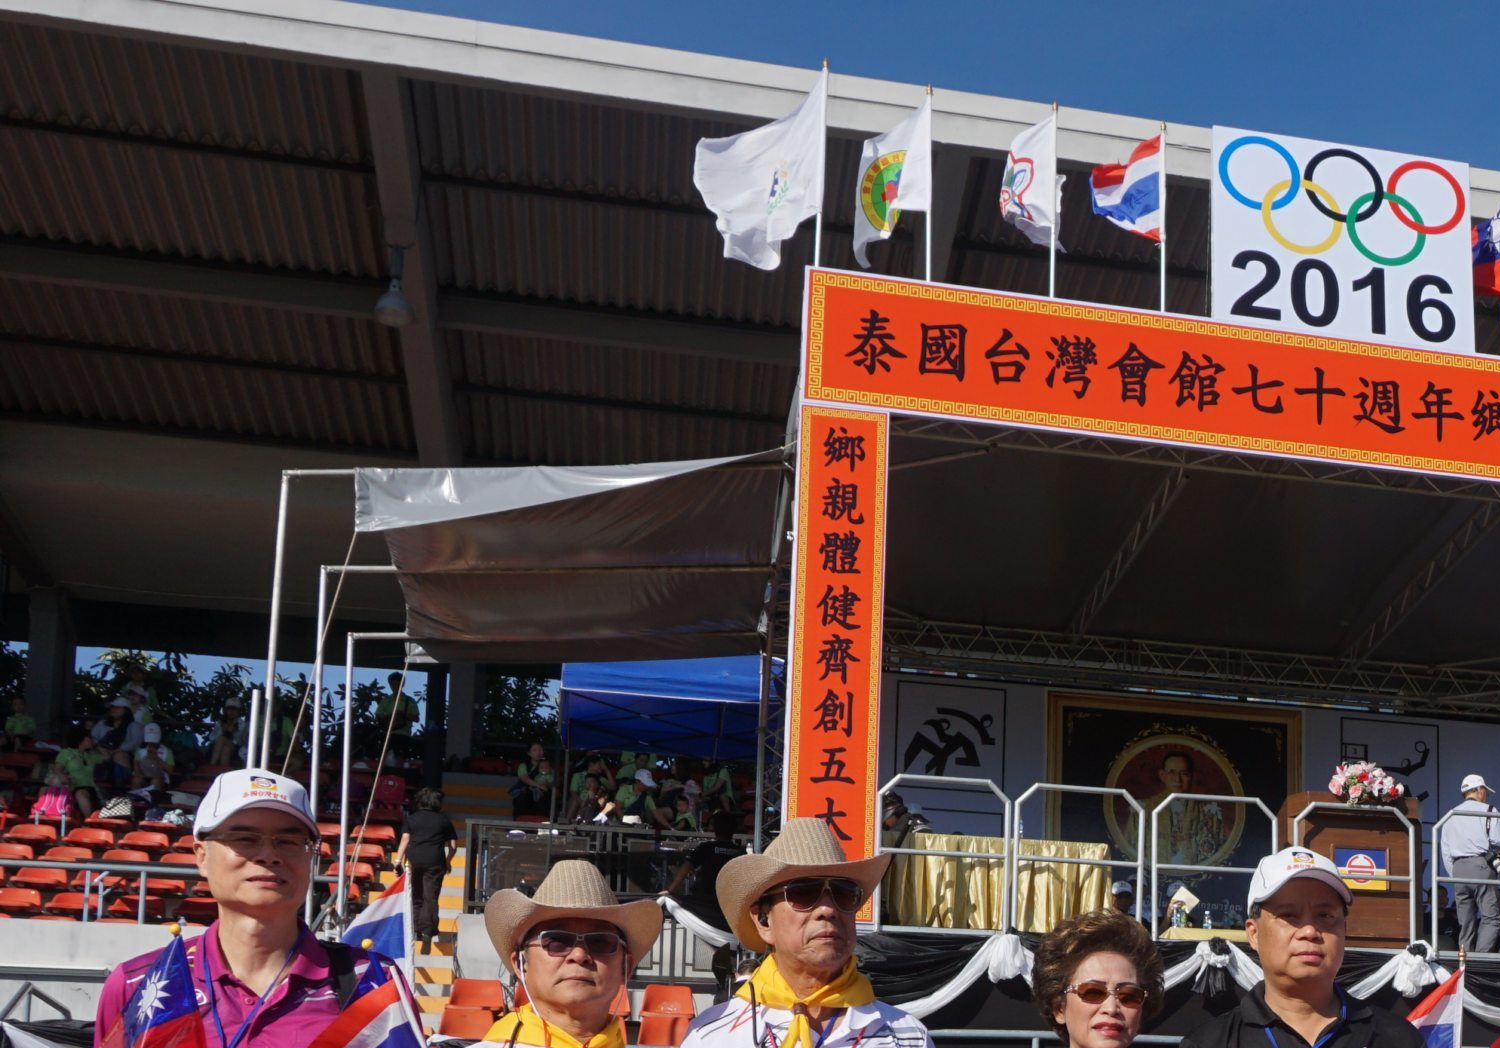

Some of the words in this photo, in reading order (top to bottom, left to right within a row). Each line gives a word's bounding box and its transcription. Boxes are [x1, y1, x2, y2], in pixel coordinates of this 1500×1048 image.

[1230, 249, 1456, 343] 2016
[810, 426, 867, 841] 鄉親體健齊創五大
